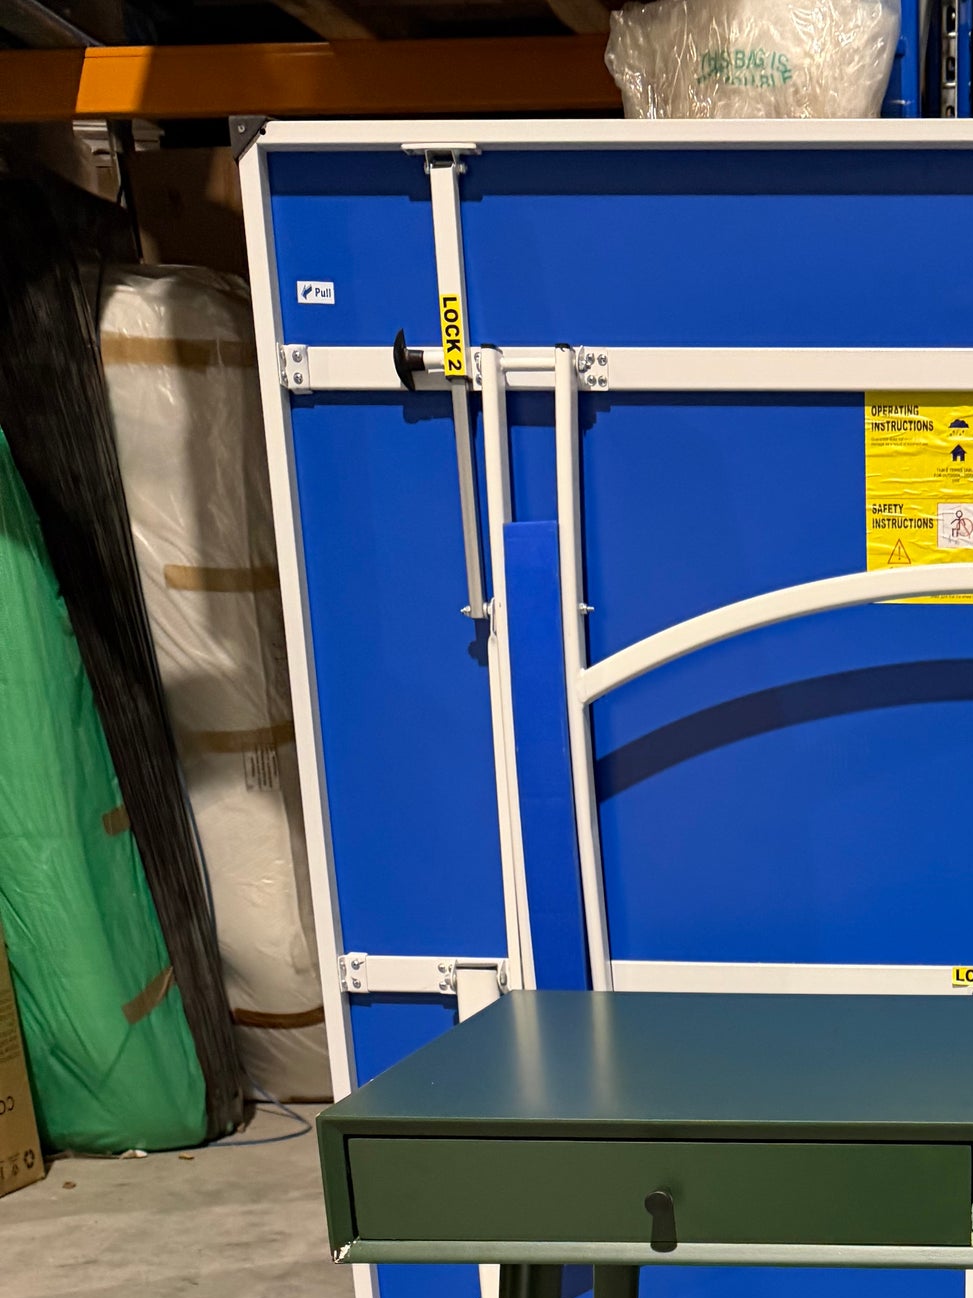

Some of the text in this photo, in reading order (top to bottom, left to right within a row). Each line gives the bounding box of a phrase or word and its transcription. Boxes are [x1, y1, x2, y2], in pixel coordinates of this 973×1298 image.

[734, 48, 765, 69] BAG
[770, 50, 789, 72] IS
[314, 287, 332, 298] Pull
[442, 296, 462, 371] LOCK 2
[871, 405, 919, 417] OPERATING
[871, 420, 934, 432] INSTRUCTIONS
[872, 503, 904, 514] SAFETY
[872, 518, 934, 529] INSTRUCTIONS
